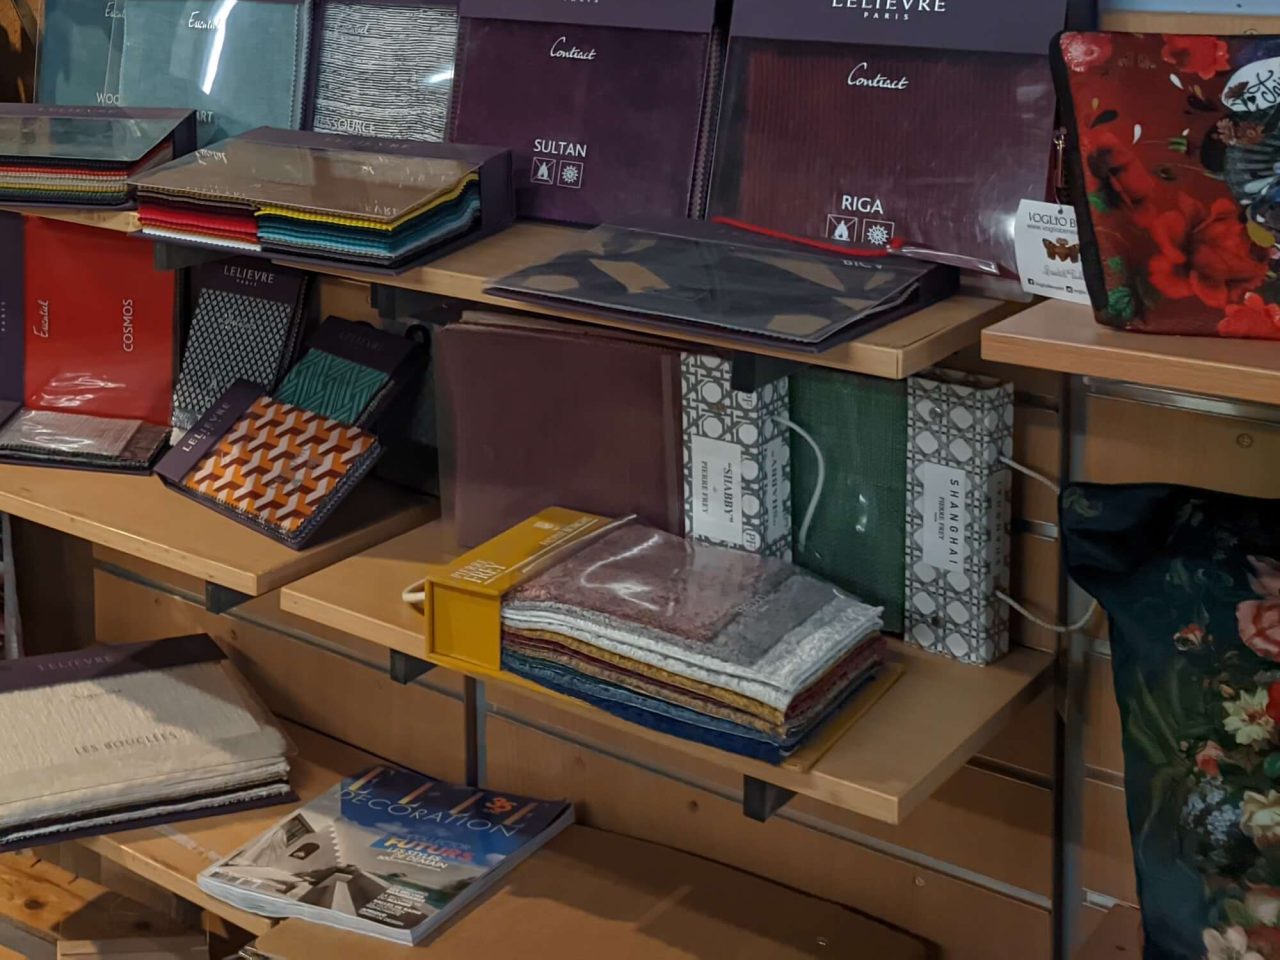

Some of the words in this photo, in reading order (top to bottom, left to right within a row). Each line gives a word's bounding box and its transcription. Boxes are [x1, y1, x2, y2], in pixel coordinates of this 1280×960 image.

[863, 12, 909, 21] PARIS
[550, 36, 597, 60] Contract
[847, 62, 910, 90] Contract
[533, 138, 587, 158] SULTAN
[841, 194, 884, 215] RIGA
[1029, 211, 1067, 227] VOGLIO
[224, 264, 275, 284] LELIEVRE
[122, 298, 134, 352] COSMOS
[949, 478, 959, 565] SHANGHAI
[37, 655, 114, 671] LELIEVRE
[74, 744, 99, 756] LES
